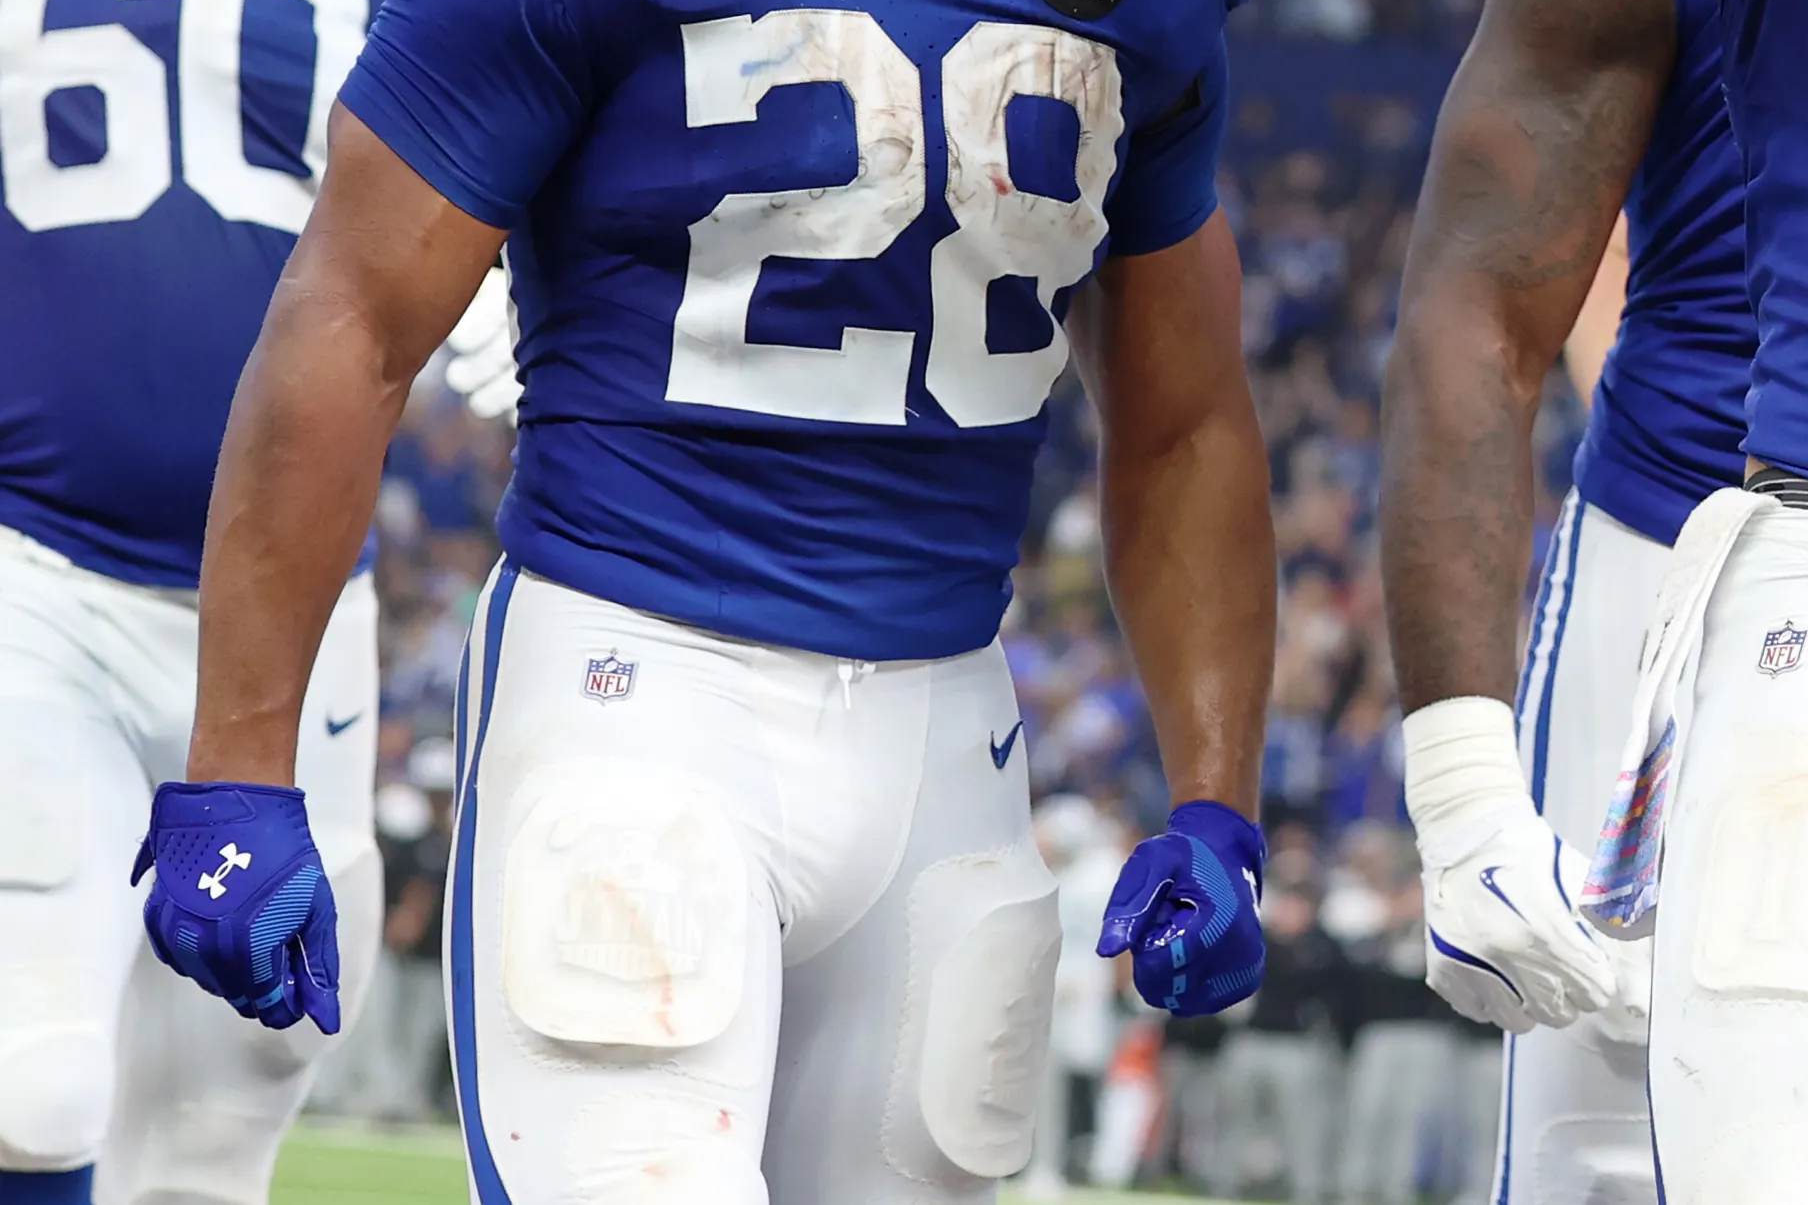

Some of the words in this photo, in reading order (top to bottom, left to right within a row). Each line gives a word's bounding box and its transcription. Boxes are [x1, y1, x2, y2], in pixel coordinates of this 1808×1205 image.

[664, 8, 1125, 429] 28
[1763, 645, 1797, 667] NFL
[589, 673, 625, 694] NFL
